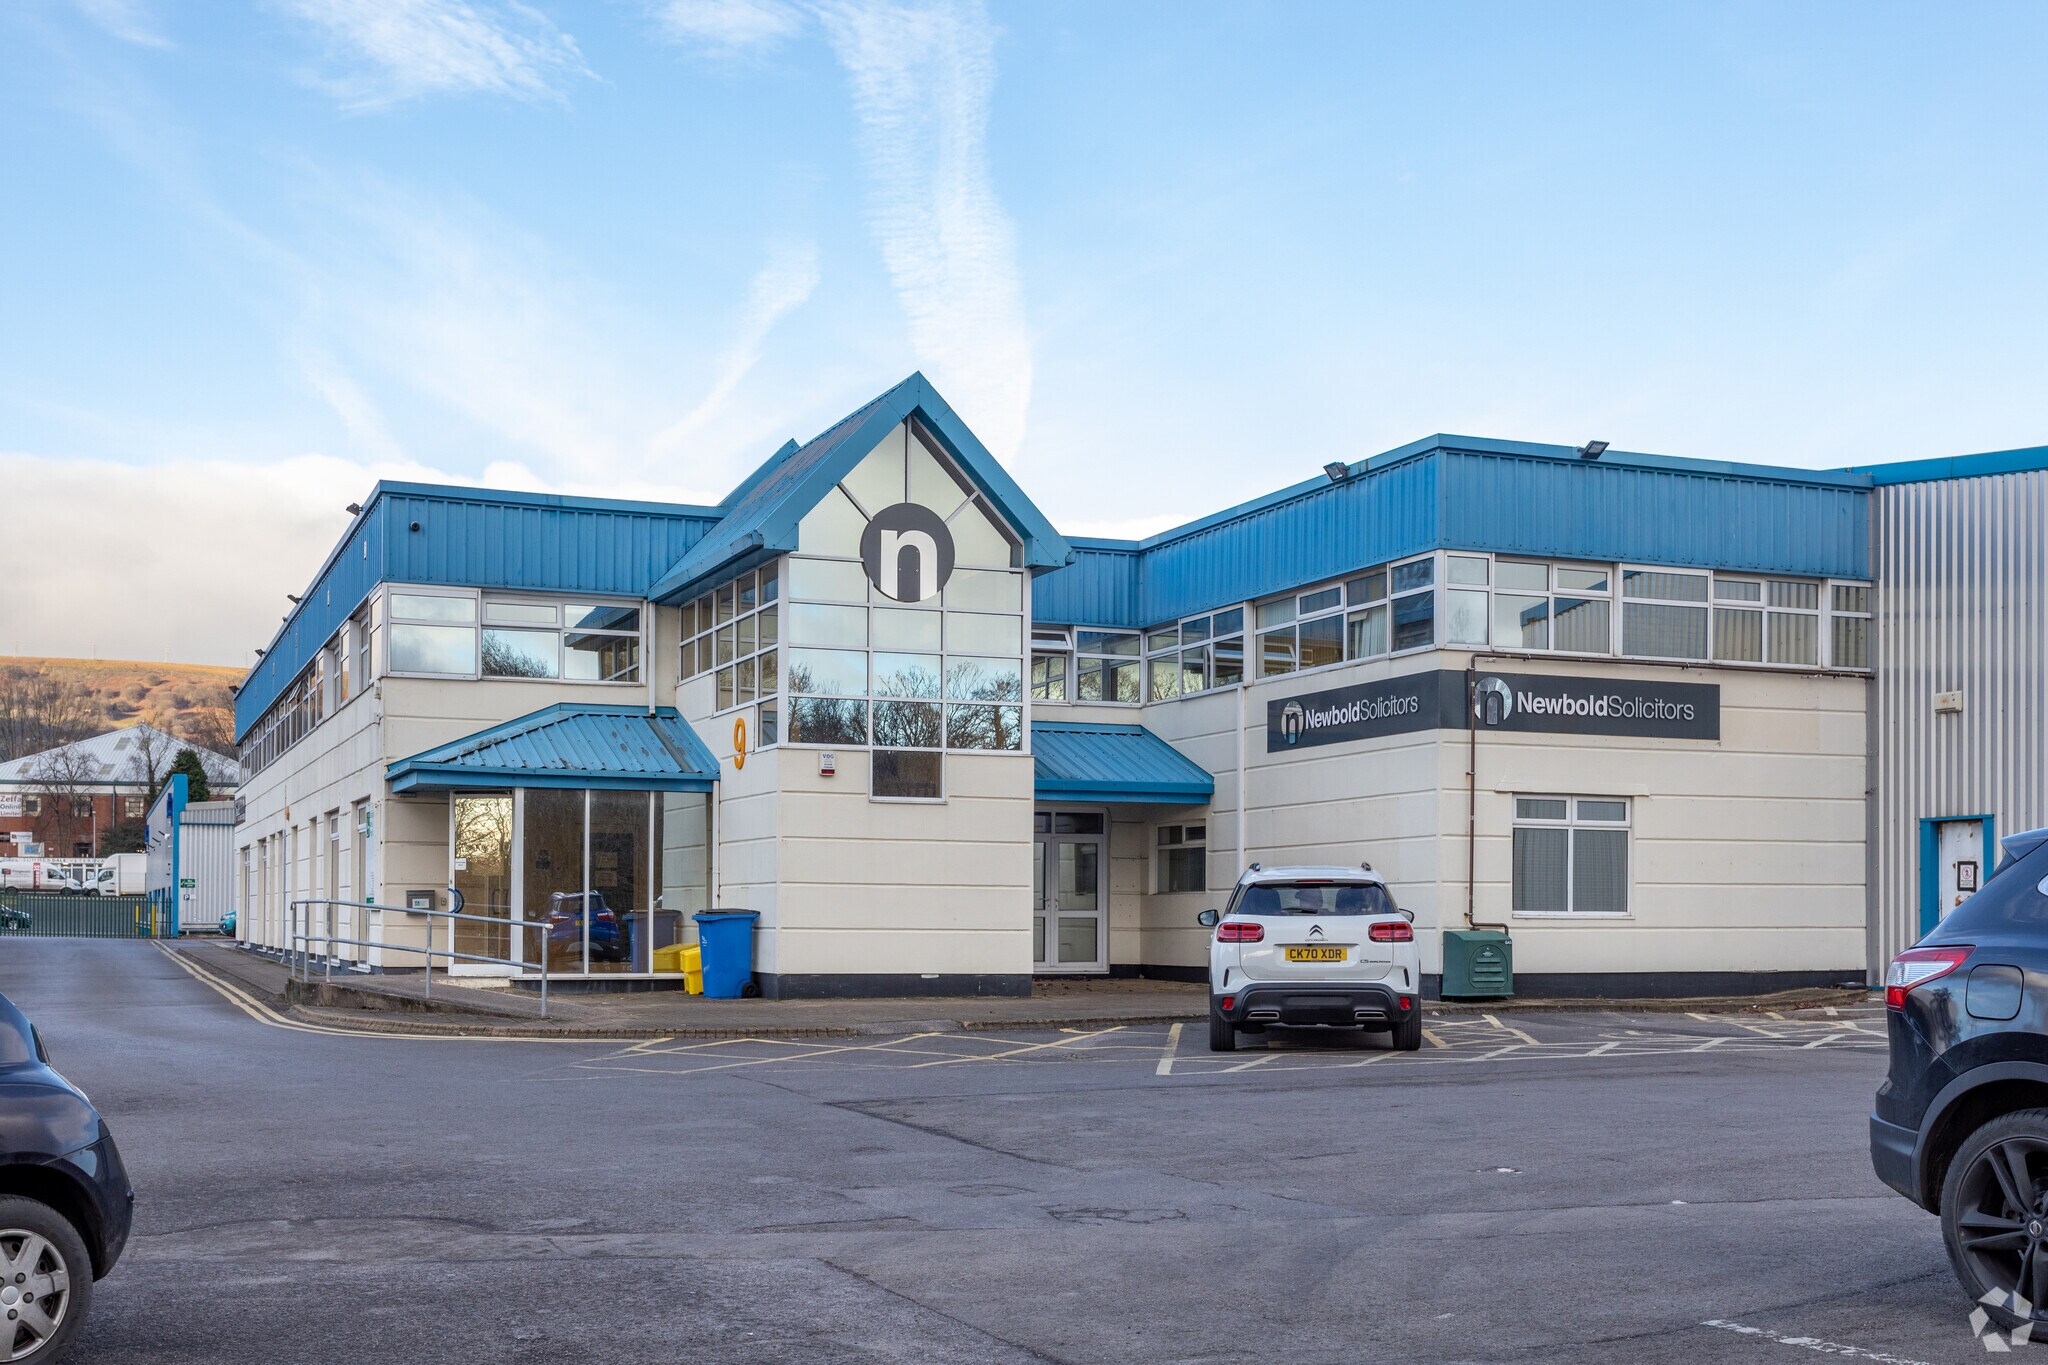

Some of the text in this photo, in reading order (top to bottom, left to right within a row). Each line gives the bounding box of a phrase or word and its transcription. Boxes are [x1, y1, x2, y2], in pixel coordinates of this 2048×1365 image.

[880, 529, 938, 601] n
[1305, 694, 1418, 730] NewboldSolicitors
[1517, 691, 1695, 721] NewboldSolicitors
[733, 717, 747, 770] 9
[1289, 949, 1342, 959] CK70 XDR
